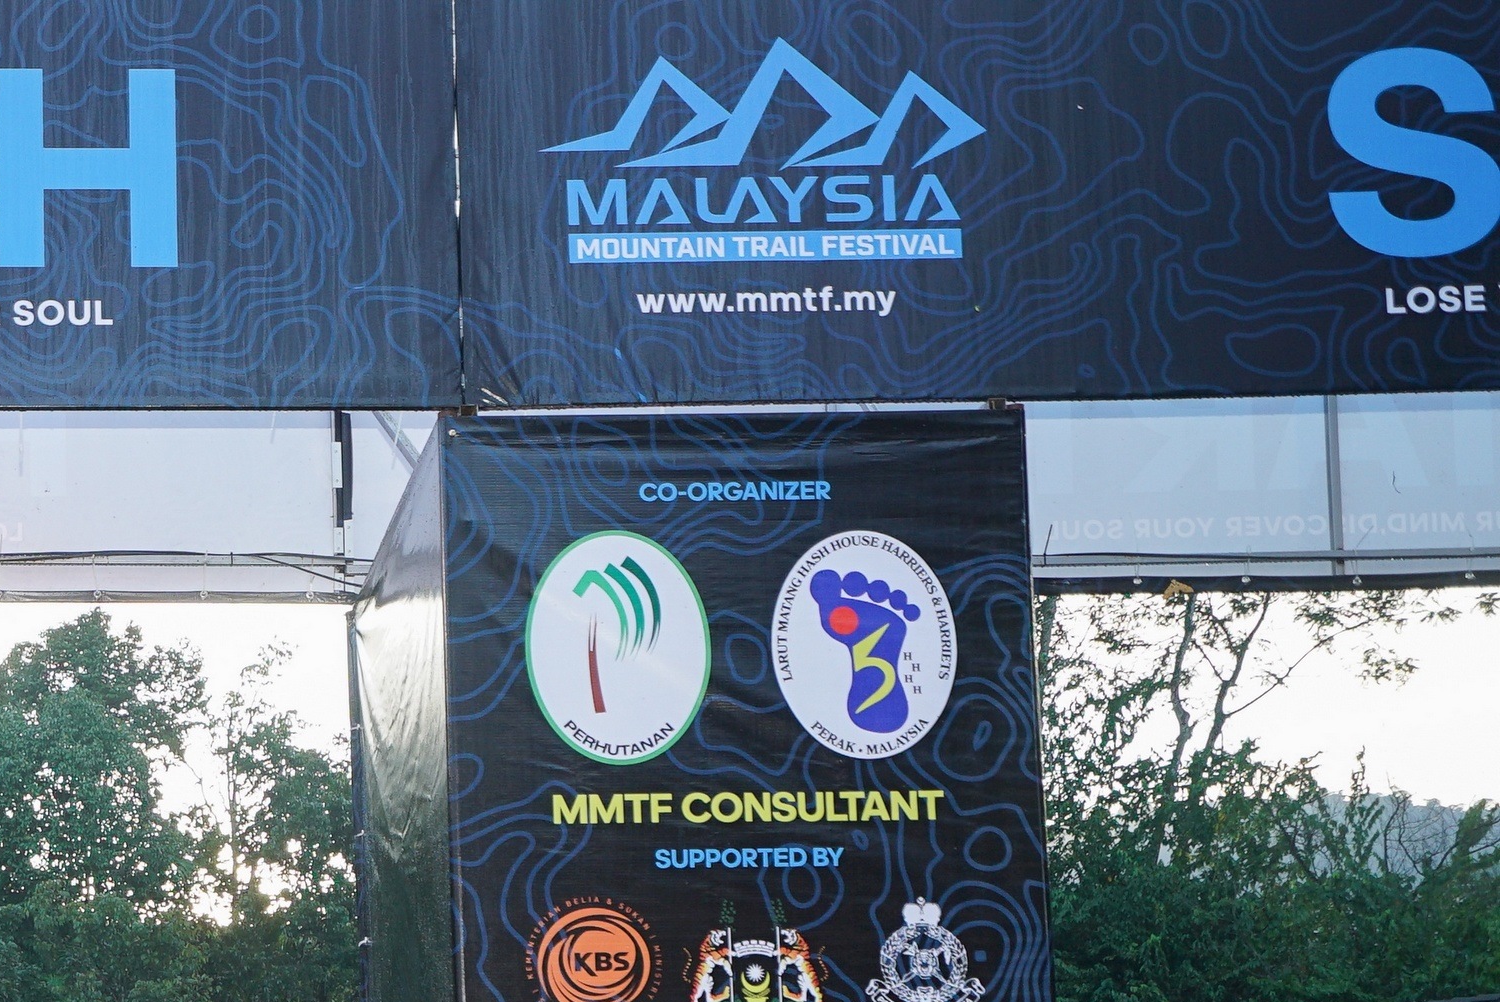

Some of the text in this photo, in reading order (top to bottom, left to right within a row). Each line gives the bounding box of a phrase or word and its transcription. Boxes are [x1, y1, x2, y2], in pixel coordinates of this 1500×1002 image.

[569, 172, 961, 226] MALAYSIA
[576, 230, 956, 259] MOUNTAIN TRAIL FESTIVAL
[12, 299, 113, 328] SOUL
[637, 286, 896, 317] www.mmtf.my
[1386, 285, 1486, 316] LOSE
[639, 481, 831, 502] CO-ORGANIZER
[776, 535, 952, 682] LARUT MATANG HASH HOUSE HARRIERS & HARRIETS
[563, 719, 675, 757] PERHUTANAN
[811, 718, 929, 755] PERAK MALAYSIA
[552, 789, 944, 825] MMTF CONSULTANT
[655, 846, 844, 869] SUPPORTED BY
[565, 896, 600, 907] BELIA
[619, 903, 651, 930] SUKAN
[574, 952, 630, 977] KBS
